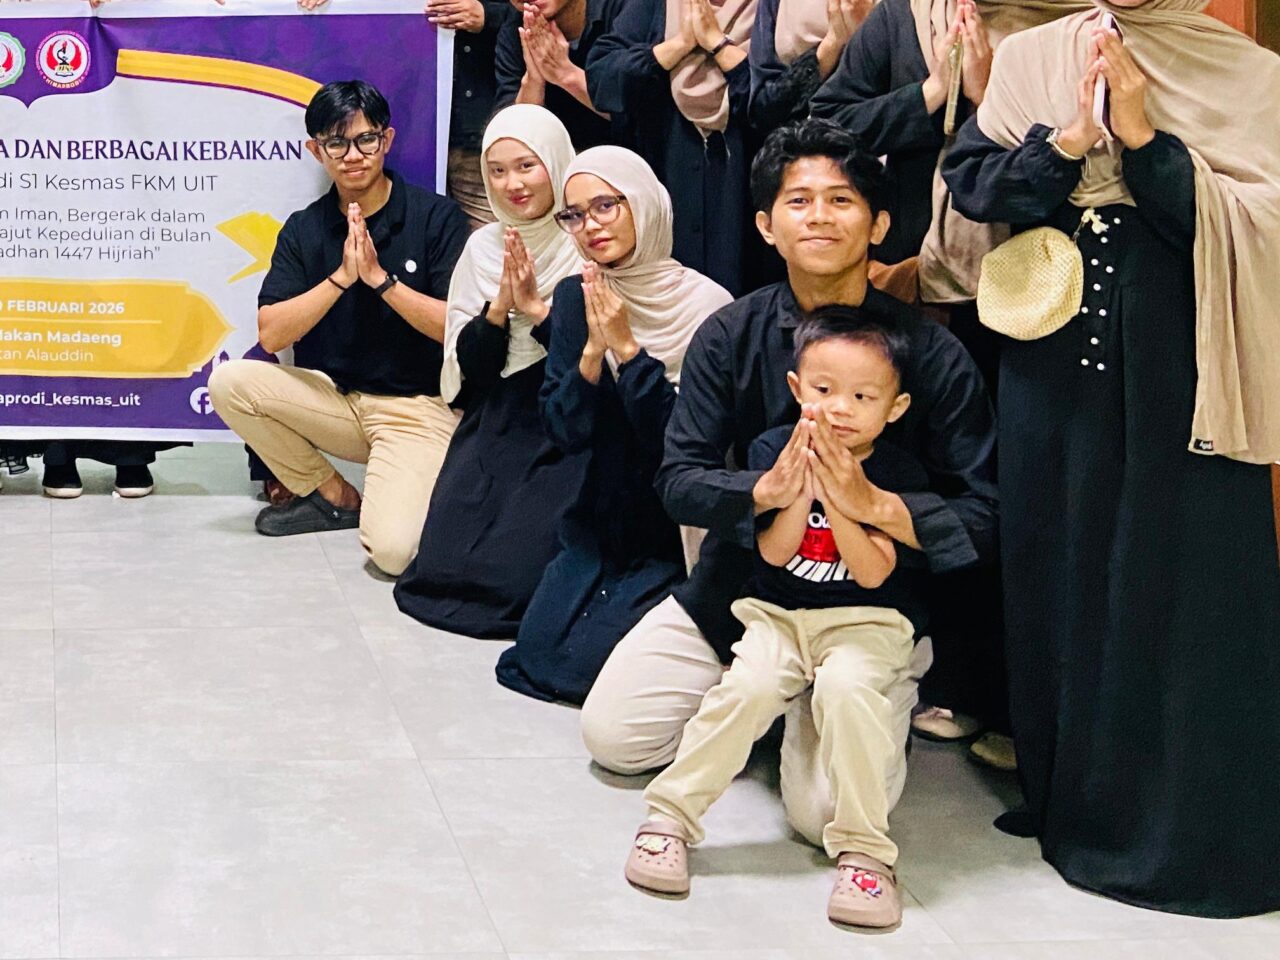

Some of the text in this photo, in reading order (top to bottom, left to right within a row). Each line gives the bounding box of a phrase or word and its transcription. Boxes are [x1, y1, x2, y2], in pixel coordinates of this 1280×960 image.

[14, 139, 62, 160] DAN
[67, 139, 179, 161] BERBAGAI
[183, 140, 302, 161] KEBAIKAN
[19, 173, 37, 189] S1
[45, 174, 125, 191] Kesmas
[131, 174, 176, 191] FKM
[184, 175, 218, 192] UIT
[15, 207, 62, 223] Iman,
[68, 208, 146, 225] Bergerak
[151, 209, 205, 224] dalam
[37, 227, 135, 244] Kepedulian
[140, 228, 156, 241] di
[161, 228, 212, 243] Bulan
[54, 246, 94, 261] 1447
[7, 300, 84, 314] FEBRUARI
[88, 301, 125, 315] 2026
[47, 330, 122, 348] Madaeng
[26, 348, 94, 362] Alauddin
